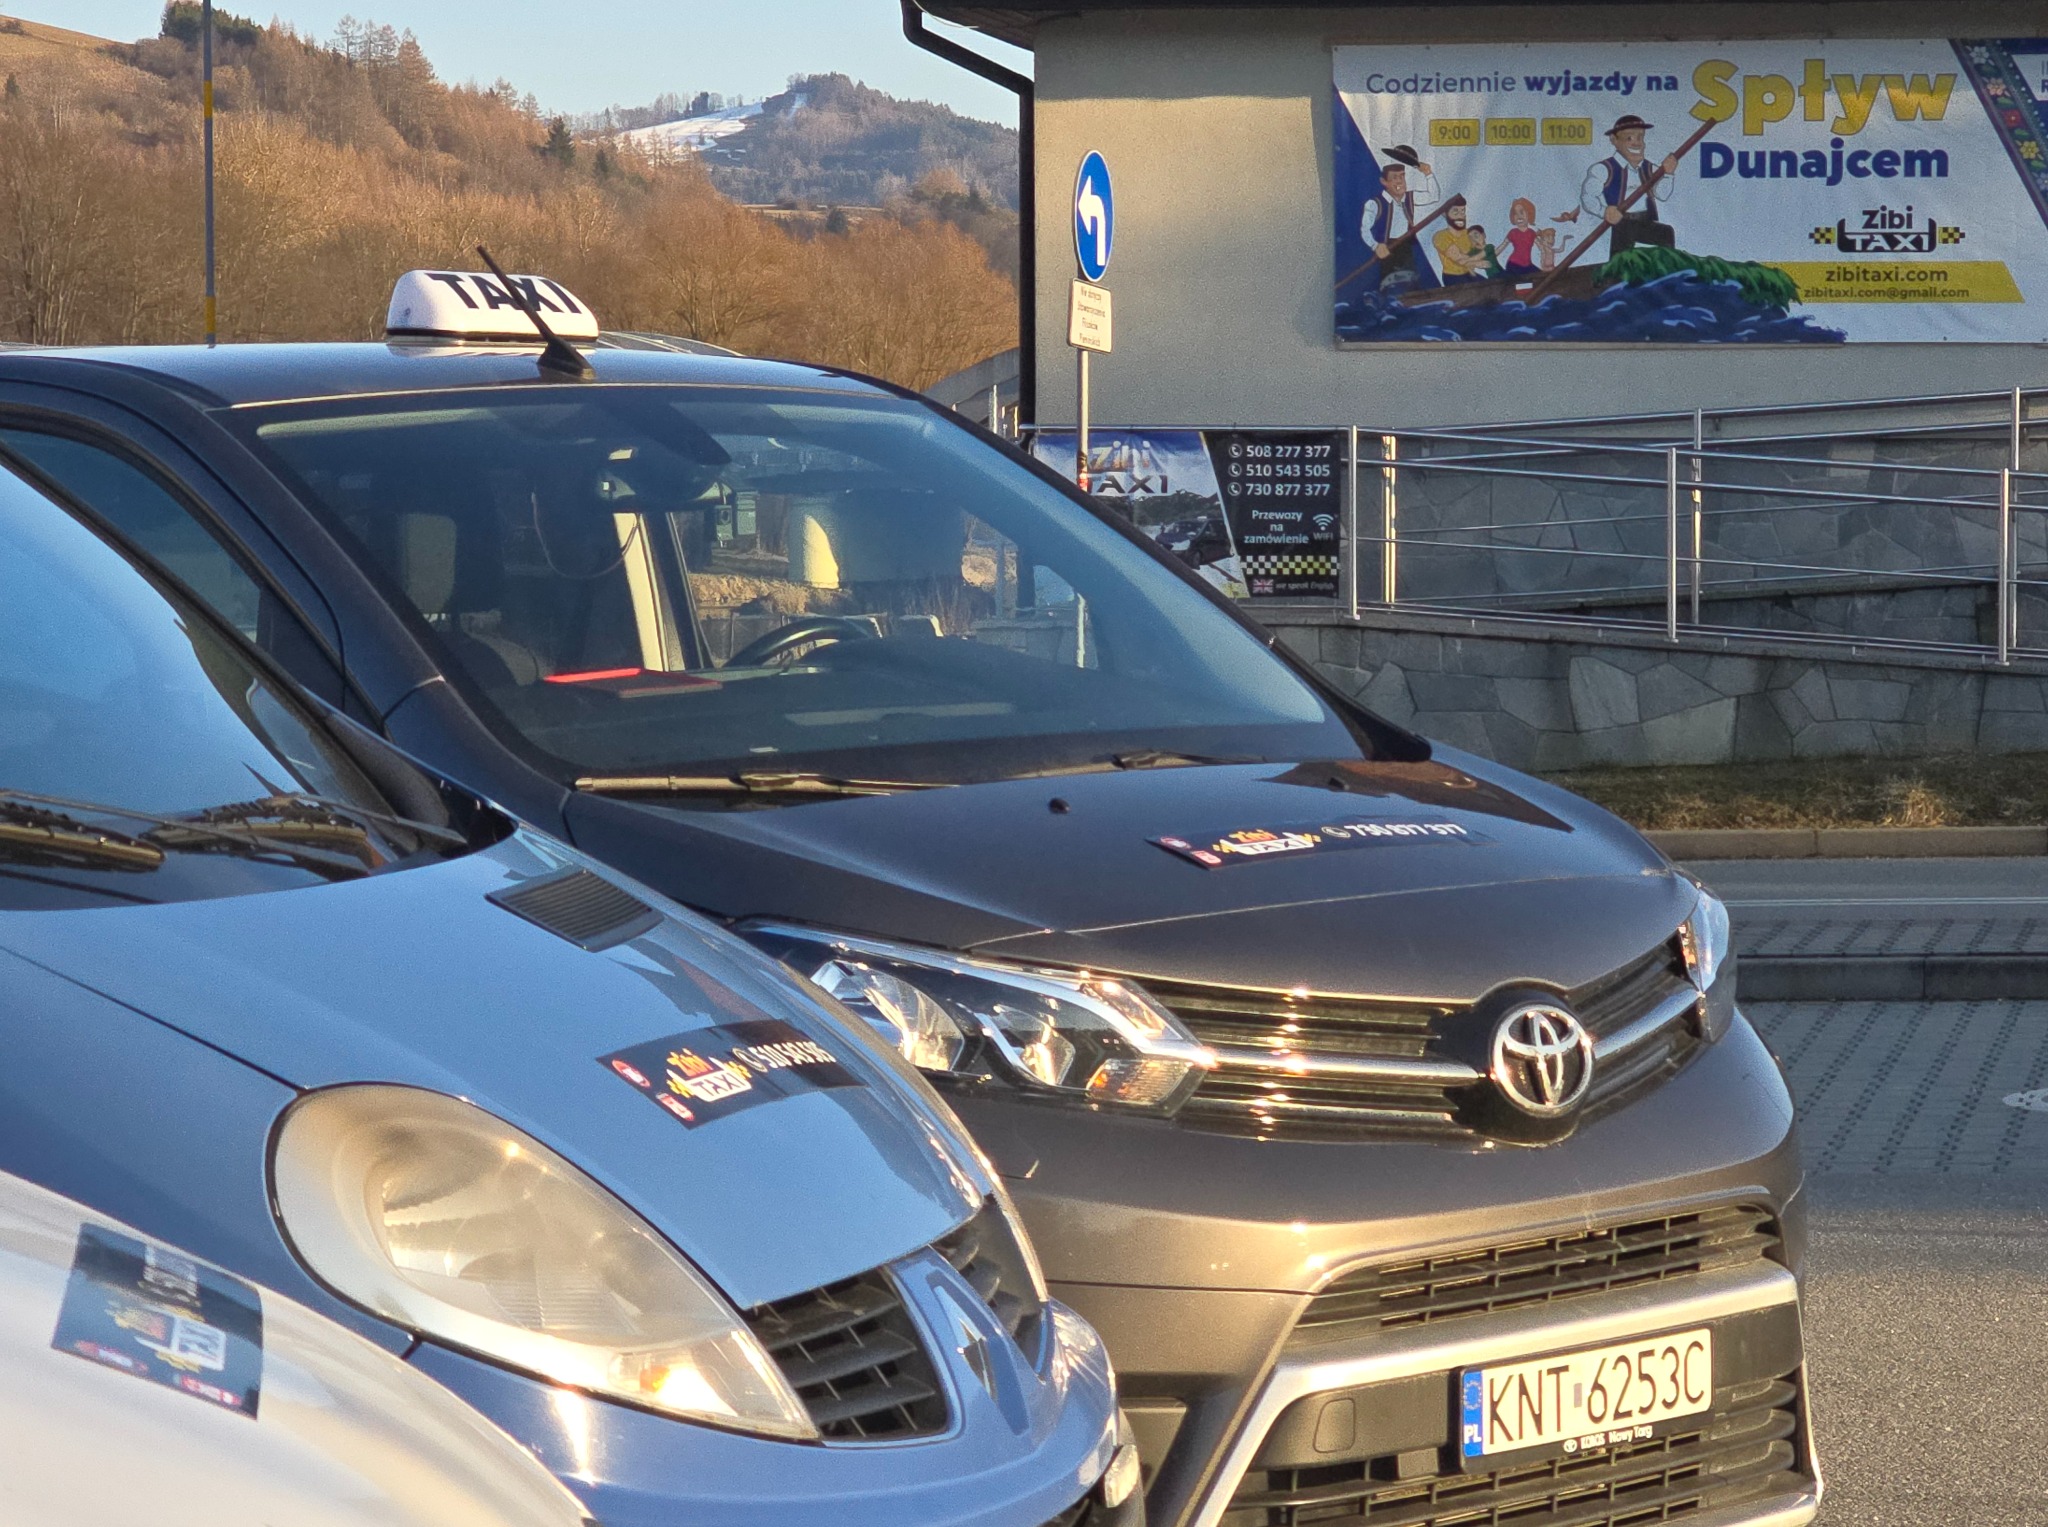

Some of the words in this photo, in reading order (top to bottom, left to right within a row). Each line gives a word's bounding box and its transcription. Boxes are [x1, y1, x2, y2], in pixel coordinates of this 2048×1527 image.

[1366, 71, 1517, 94] Codziennie
[1523, 69, 1638, 95] wyjazdy
[1645, 73, 1680, 91] na
[1689, 58, 1959, 136] Spływ
[1438, 125, 1472, 140] 9:00
[1491, 124, 1532, 140] 10:00
[1549, 124, 1587, 140] 11:00
[1700, 137, 1949, 187] Dunajcem
[1861, 204, 1914, 230] Zibi
[1845, 234, 1930, 251] TAXI
[1825, 267, 1948, 283] zibitaxi.com
[425, 273, 582, 314] TAXI
[1804, 286, 1970, 299] zibitaxi.com@gmail.com
[1246, 445, 1272, 458] 508
[1275, 445, 1301, 458] 277
[1305, 445, 1330, 458] 377
[1246, 464, 1272, 477] 510
[1275, 464, 1301, 477] 543
[1305, 464, 1330, 477] 505
[1246, 483, 1272, 496] 730
[1275, 483, 1301, 496] 877
[1305, 483, 1330, 496] 377
[1252, 510, 1303, 521] Przewozy
[1270, 523, 1284, 532] na
[1244, 534, 1309, 544] zamówienie
[690, 1072, 746, 1097] TAXI
[1489, 1364, 1570, 1445] KNT
[1587, 1340, 1705, 1424] 6253C
[1464, 1424, 1482, 1443] PL
[1633, 1425, 1653, 1439] Targ
